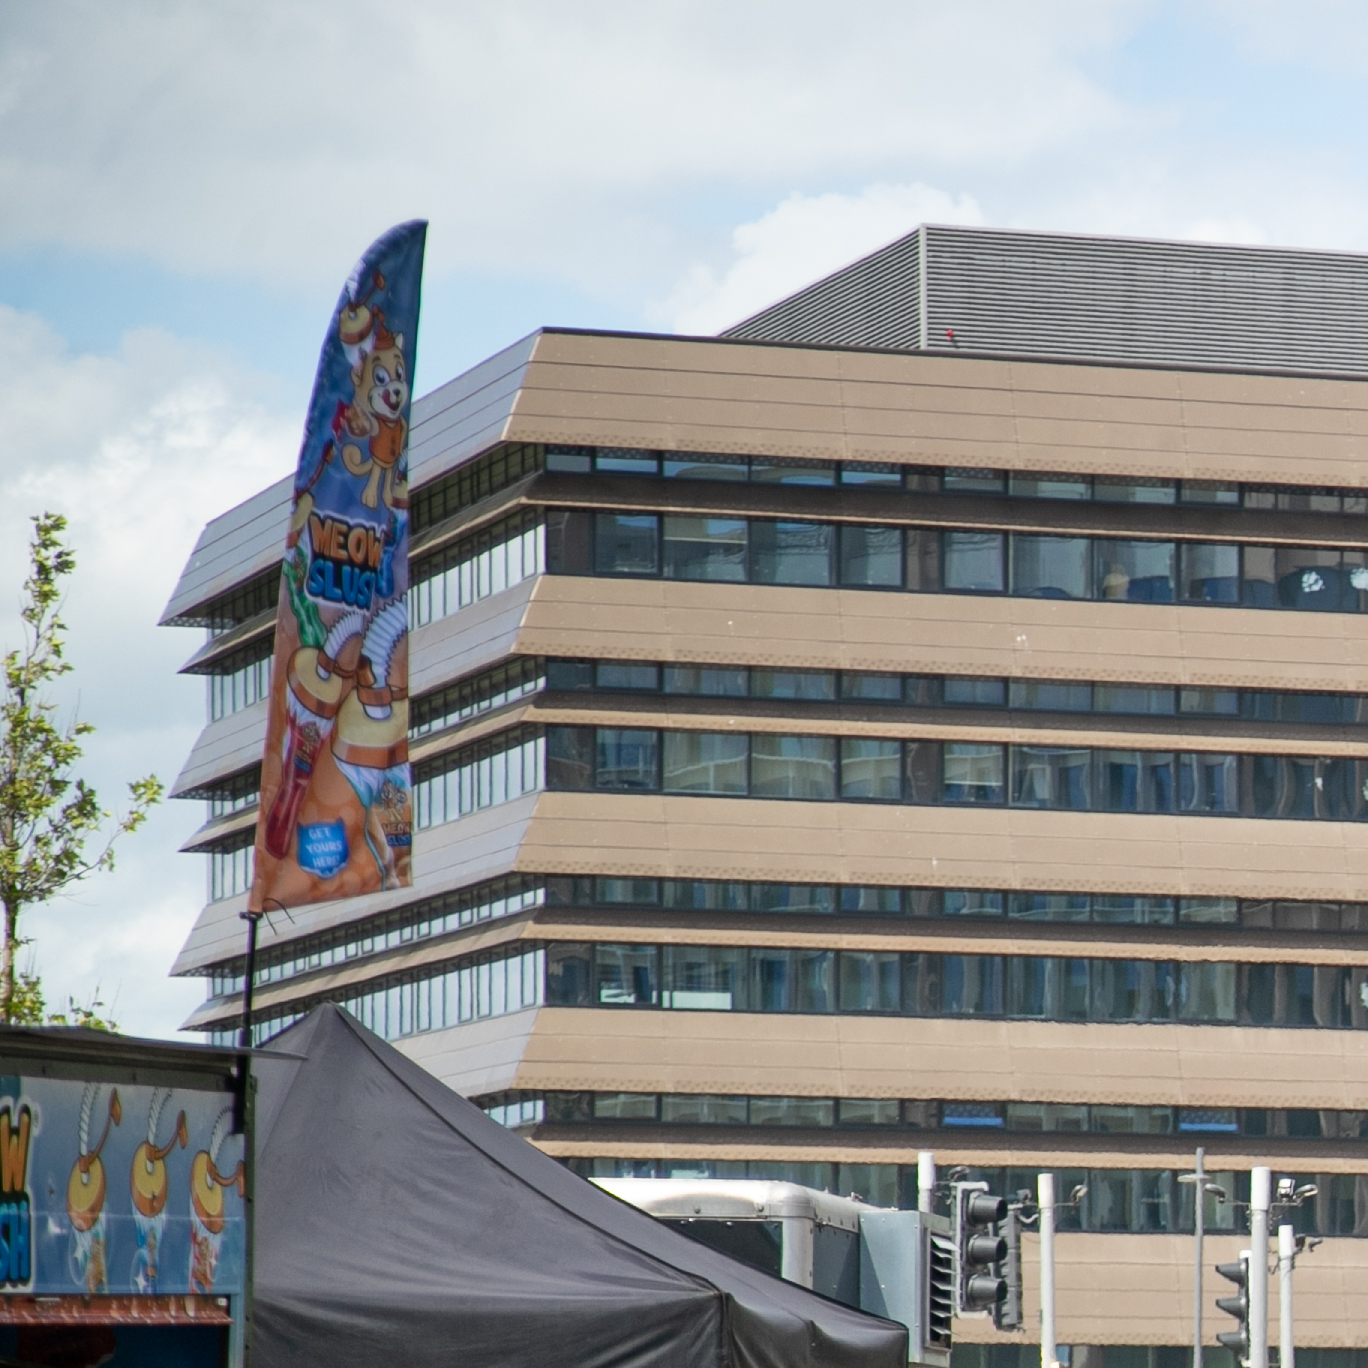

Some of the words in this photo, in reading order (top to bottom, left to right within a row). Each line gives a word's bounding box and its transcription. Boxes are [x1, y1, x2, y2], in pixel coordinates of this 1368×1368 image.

[310, 515, 382, 567] MEOW
[309, 559, 376, 611] SLUS
[306, 841, 342, 853] YOURS
[308, 827, 330, 839] GET
